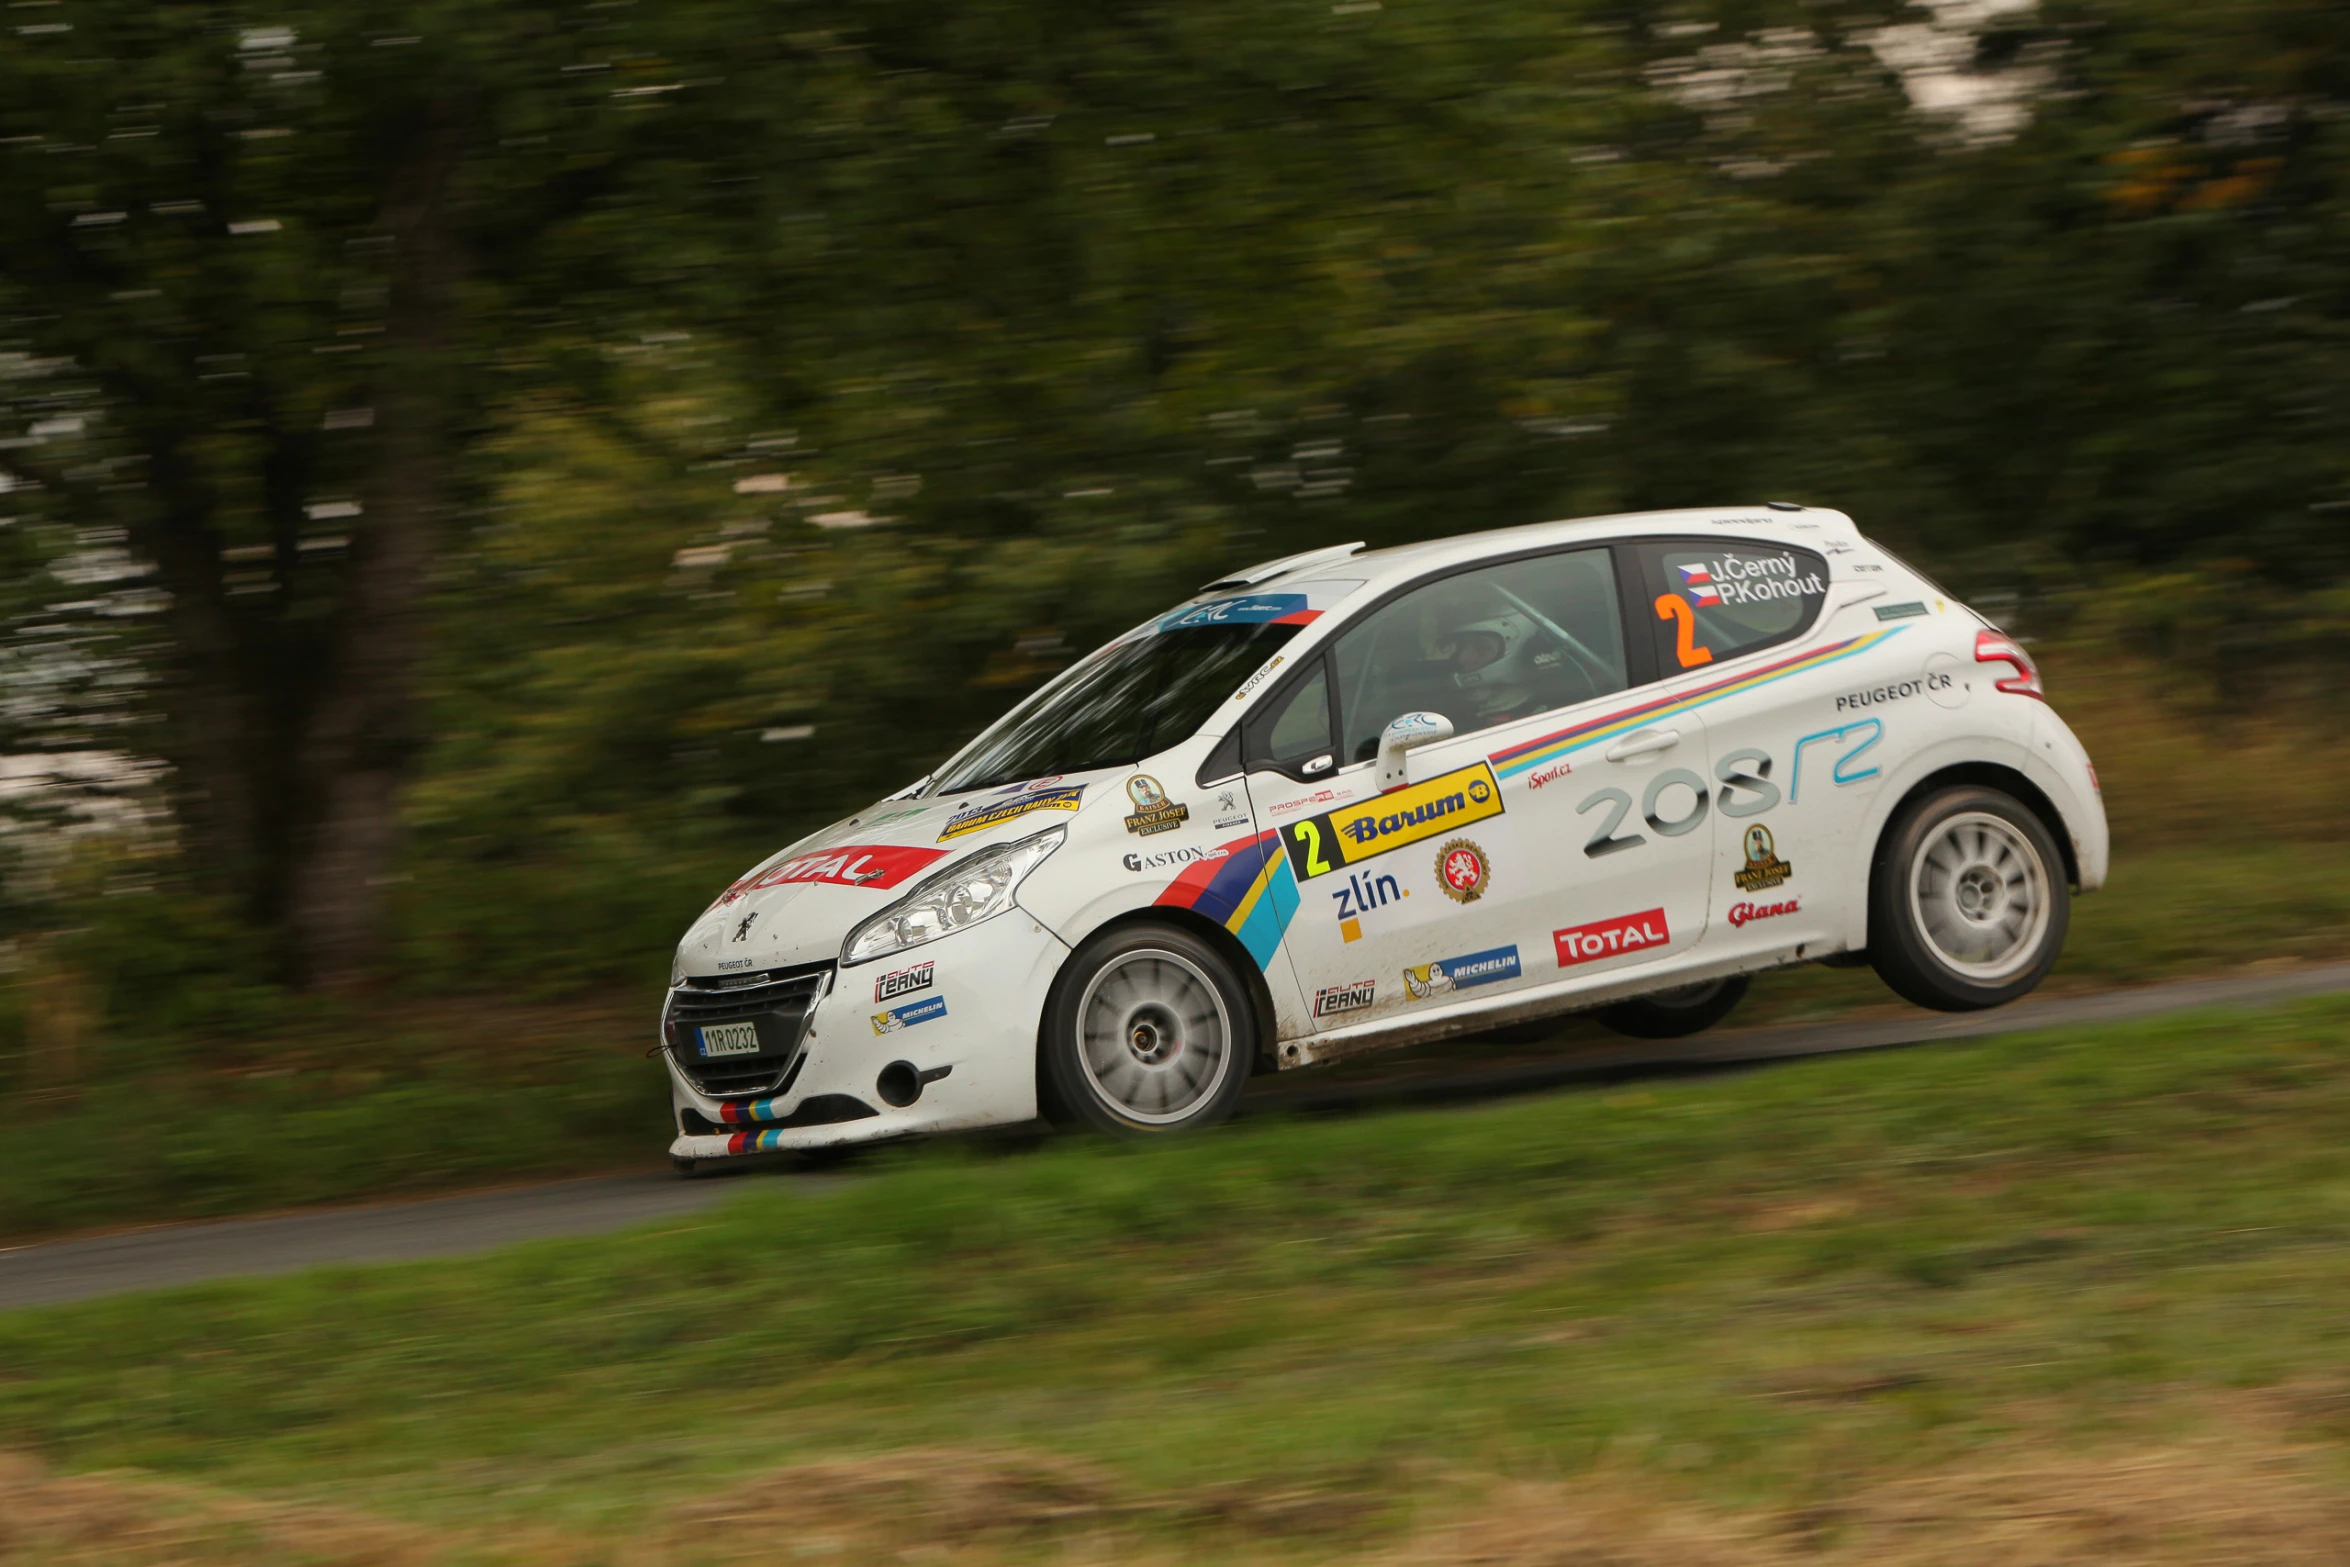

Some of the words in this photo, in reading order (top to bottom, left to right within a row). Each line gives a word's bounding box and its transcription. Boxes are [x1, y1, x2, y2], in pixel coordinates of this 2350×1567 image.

[1718, 572, 1827, 606] P.Kohout
[1654, 593, 1714, 669] 2
[1835, 678, 1922, 712] PEUGEOT
[1927, 672, 1953, 692] ČR
[1126, 813, 1158, 829] FRANZ
[1158, 806, 1187, 822] JOSEF
[1140, 820, 1179, 836] EXCLUSIVE
[1294, 820, 1332, 878] 2
[1348, 791, 1467, 845] Barum
[1122, 845, 1204, 873] GASTON
[1559, 921, 1665, 959] TOTAL
[717, 960, 744, 971] PEUGEOT
[744, 958, 753, 968] ČR
[1453, 955, 1517, 978] MICHELIN
[902, 1001, 943, 1020] MICHELIN
